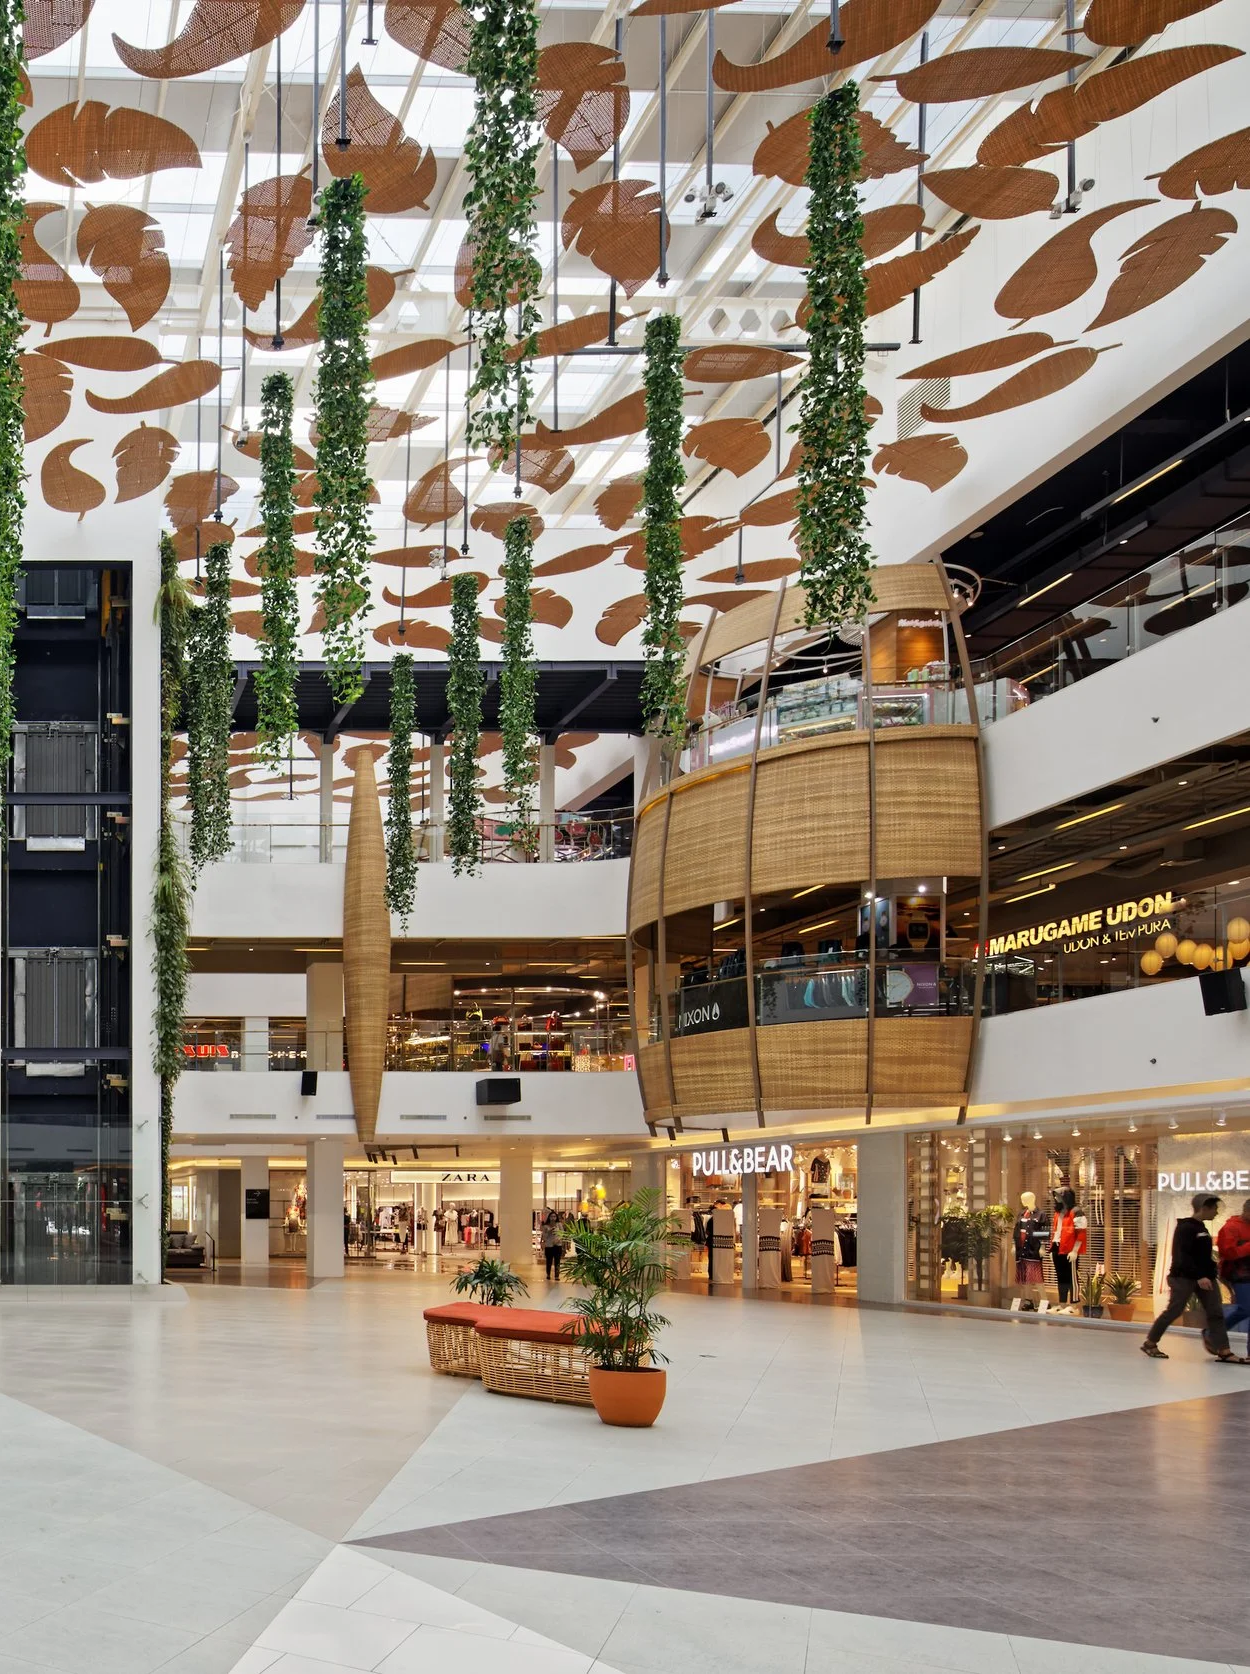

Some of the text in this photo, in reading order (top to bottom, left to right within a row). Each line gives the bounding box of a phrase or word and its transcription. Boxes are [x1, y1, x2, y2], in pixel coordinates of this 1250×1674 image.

[989, 892, 1172, 956] MARUGAME UDON
[1063, 936, 1100, 954] UDON
[1102, 933, 1112, 945] &
[692, 1144, 794, 1177] PULL&BEAR
[442, 1173, 490, 1182] ZARA
[1157, 1170, 1250, 1192] PULL&BE
